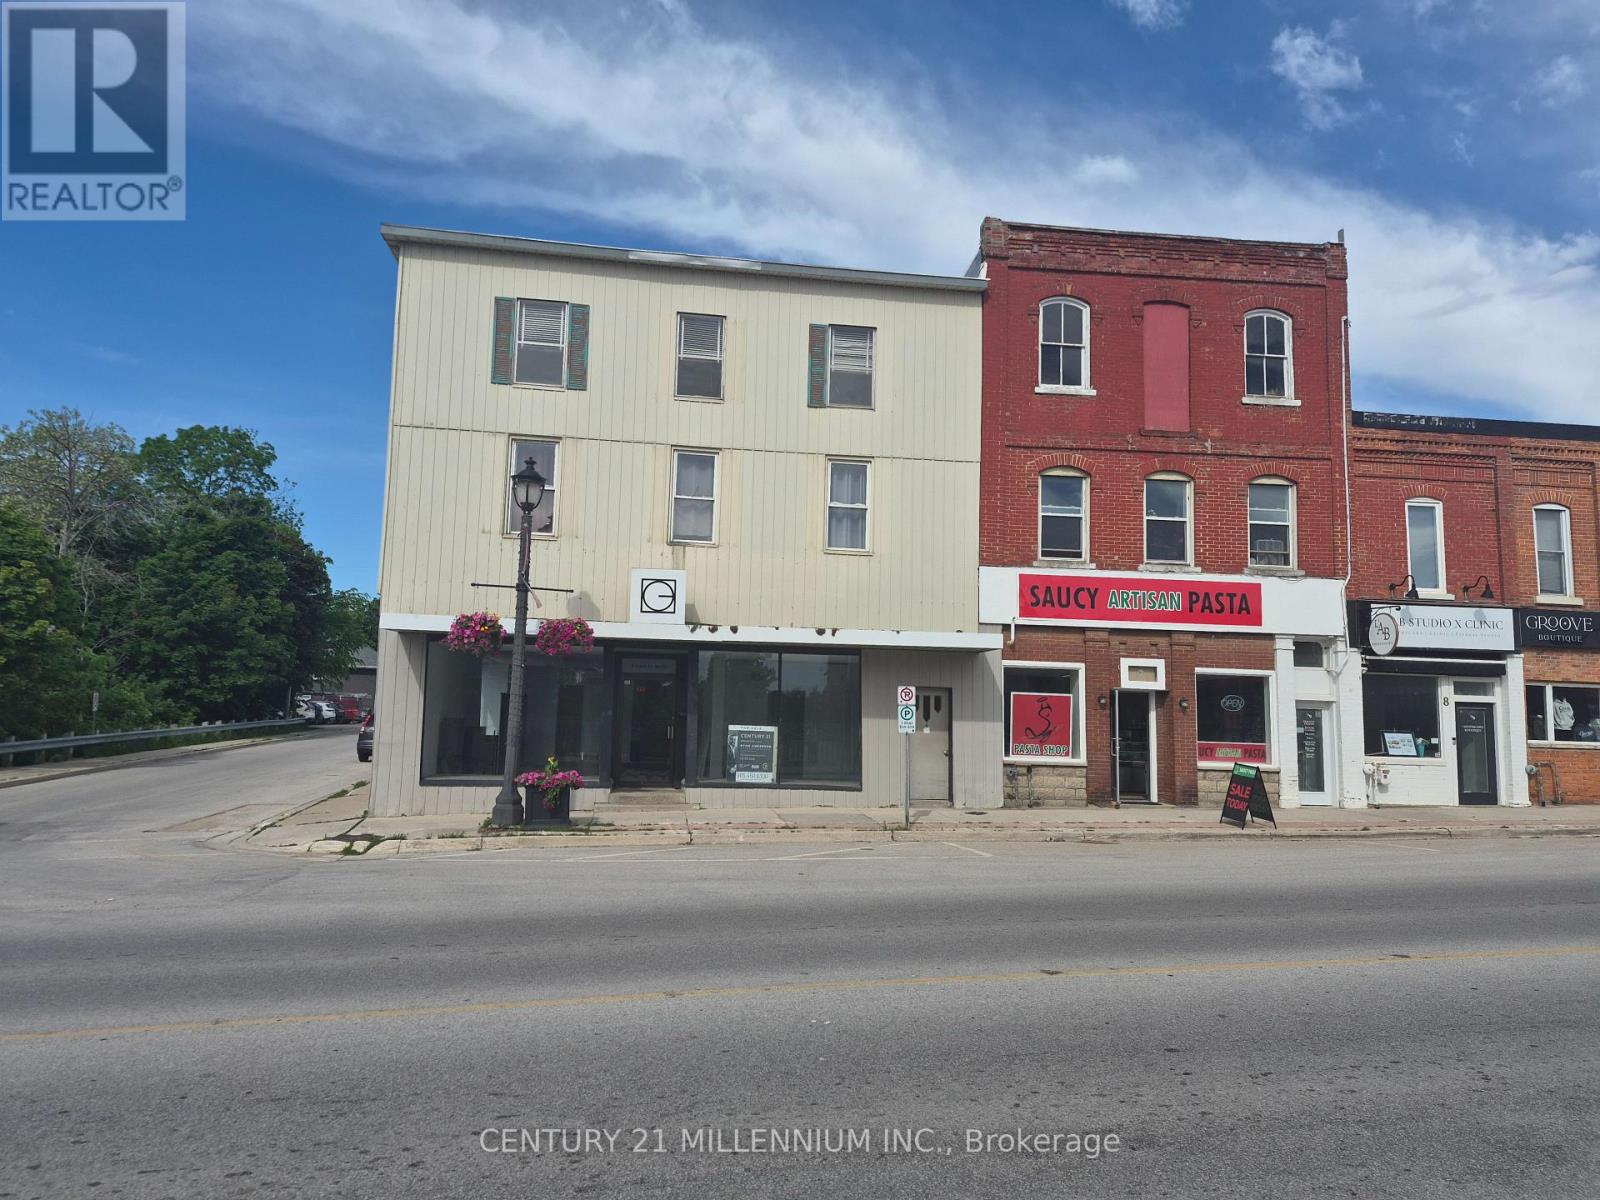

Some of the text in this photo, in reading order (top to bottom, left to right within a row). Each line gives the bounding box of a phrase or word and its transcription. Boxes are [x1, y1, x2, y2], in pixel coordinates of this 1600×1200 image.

[1030, 584, 1251, 615] SAUCY ARTISAN PASTA
[1409, 618, 1452, 628] STUDIO
[1454, 620, 1462, 629] X
[1464, 619, 1504, 630] CLINIC
[1526, 615, 1593, 632] GROOVE
[1538, 634, 1582, 642] BOUTIQUE
[1443, 696, 1449, 706] 8
[1013, 744, 1069, 755] PASTA SHOP
[1244, 749, 1265, 759] PASTA
[1229, 783, 1252, 798] SALE
[1227, 798, 1248, 811] TODAY
